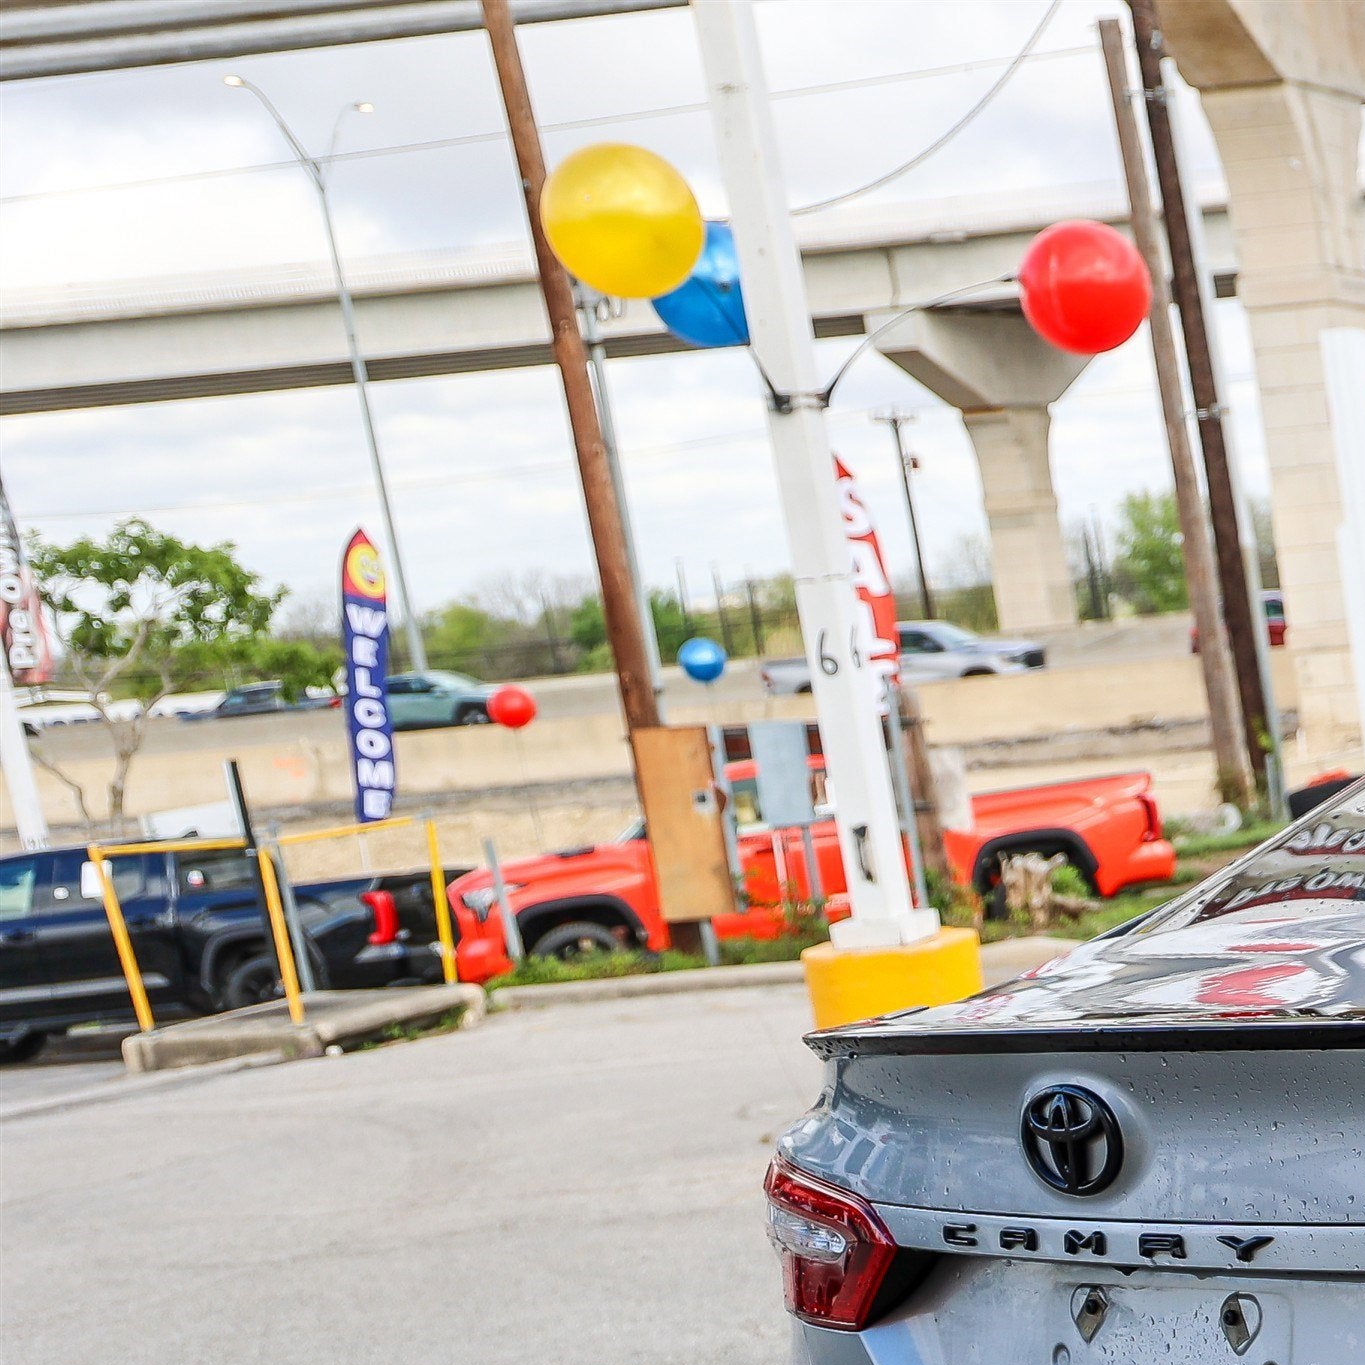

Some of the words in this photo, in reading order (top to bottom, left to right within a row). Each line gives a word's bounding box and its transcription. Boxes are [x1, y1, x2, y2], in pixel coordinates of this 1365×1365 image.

[9, 608, 38, 669] Pre
[345, 603, 394, 818] WELCOME
[943, 1222, 1275, 1263] CAMRY
